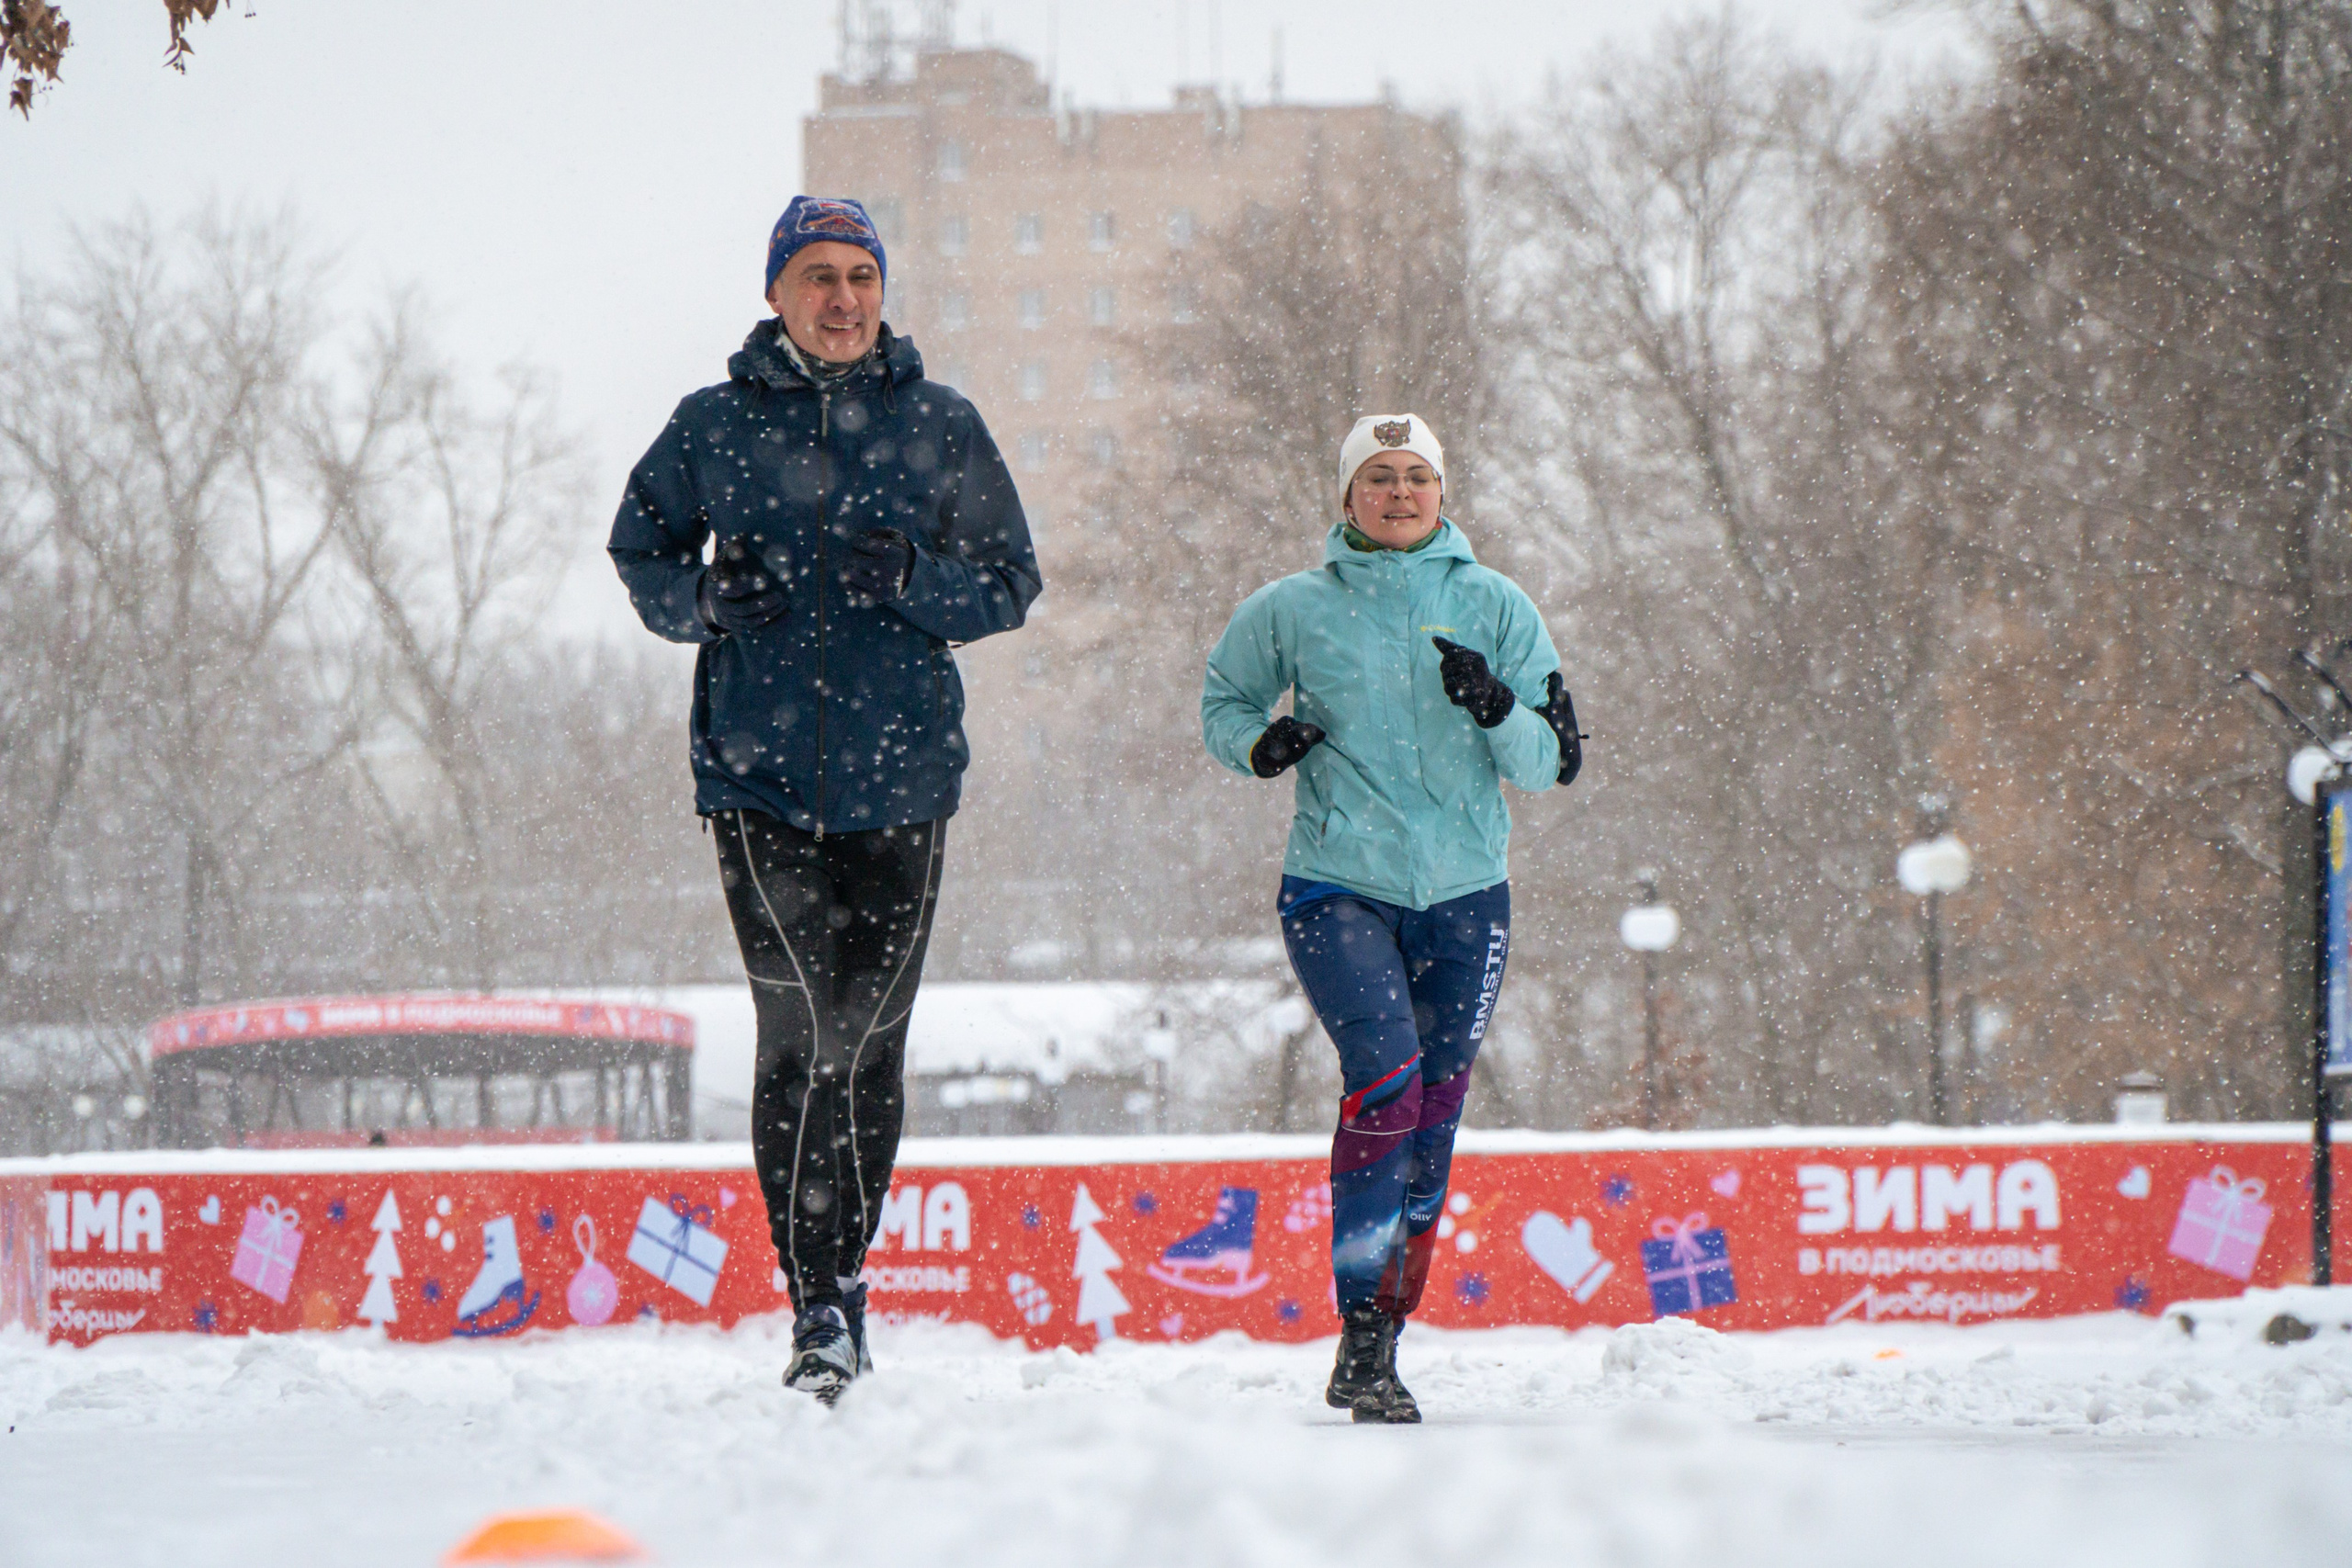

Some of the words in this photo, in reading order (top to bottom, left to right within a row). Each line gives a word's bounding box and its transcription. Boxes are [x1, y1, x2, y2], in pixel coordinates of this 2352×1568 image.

[1469, 929, 1505, 1040] BMSTU
[1479, 961, 1504, 1038] IENTEERING
[867, 1181, 971, 1251] МА
[1797, 1159, 2061, 1234] ЗИМА
[857, 1266, 971, 1293] ОСКОВЬЕ
[1826, 1244, 2062, 1278] ПОДМОСКОВЬЕ
